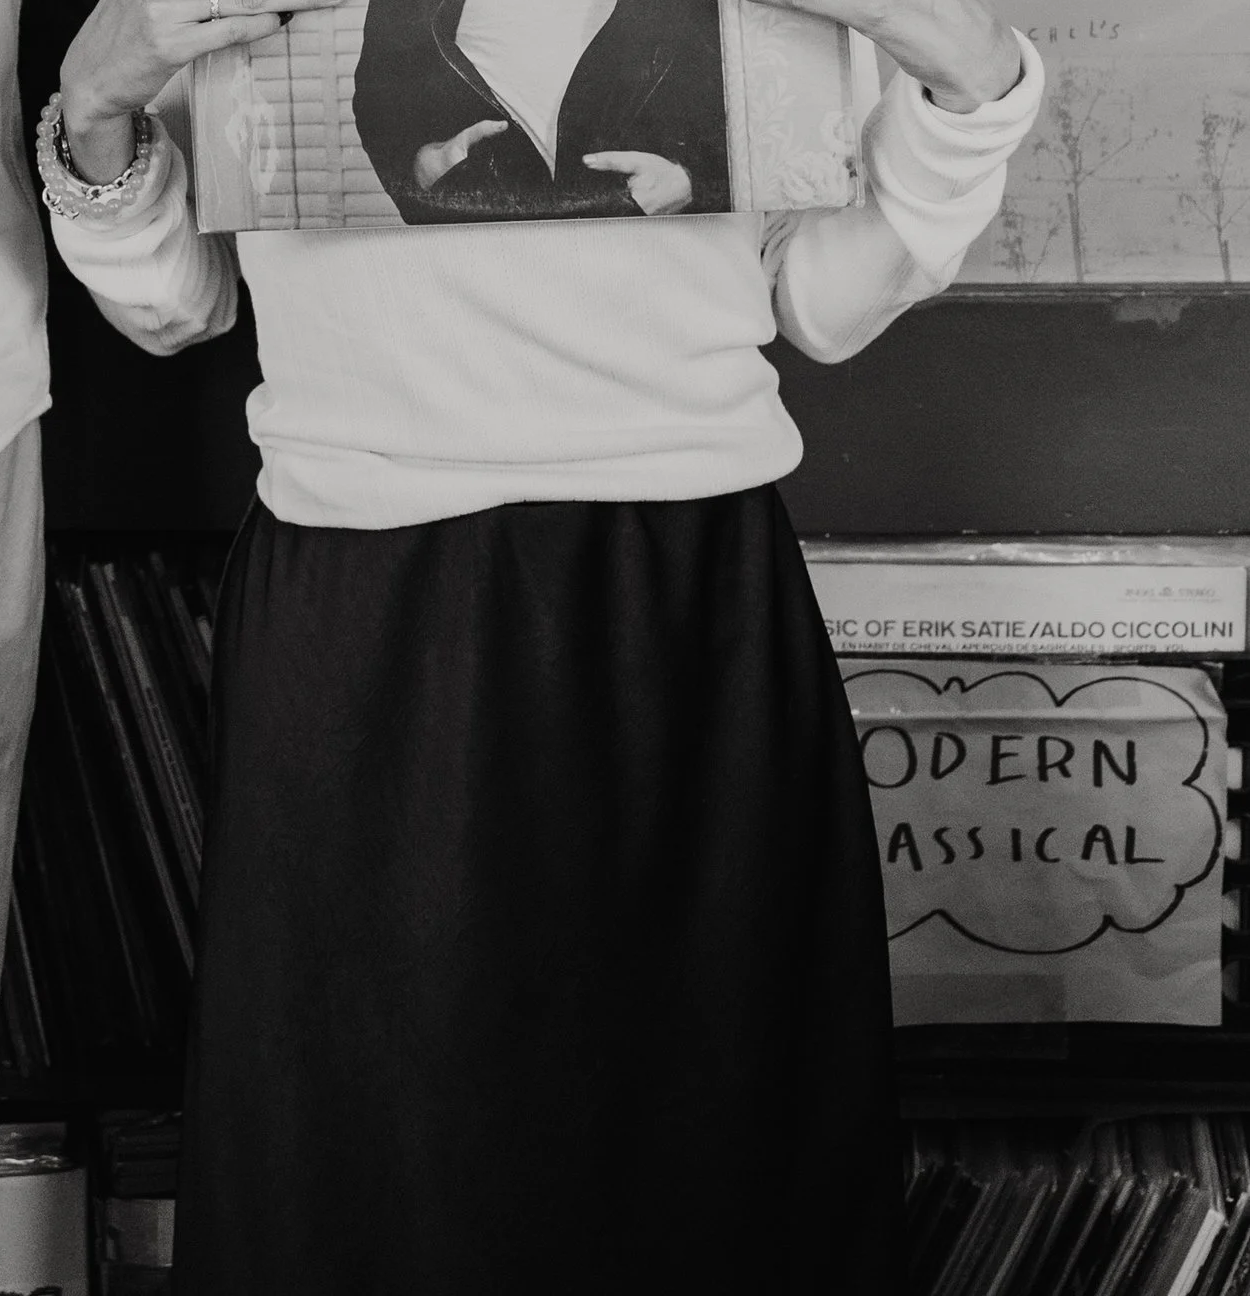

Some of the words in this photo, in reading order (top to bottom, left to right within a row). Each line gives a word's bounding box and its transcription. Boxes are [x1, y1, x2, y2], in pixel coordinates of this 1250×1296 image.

[865, 620, 897, 638] OF
[903, 620, 955, 638] ERIK
[1111, 621, 1234, 639] CICCOLINI
[886, 823, 1165, 872] ASSICAL
